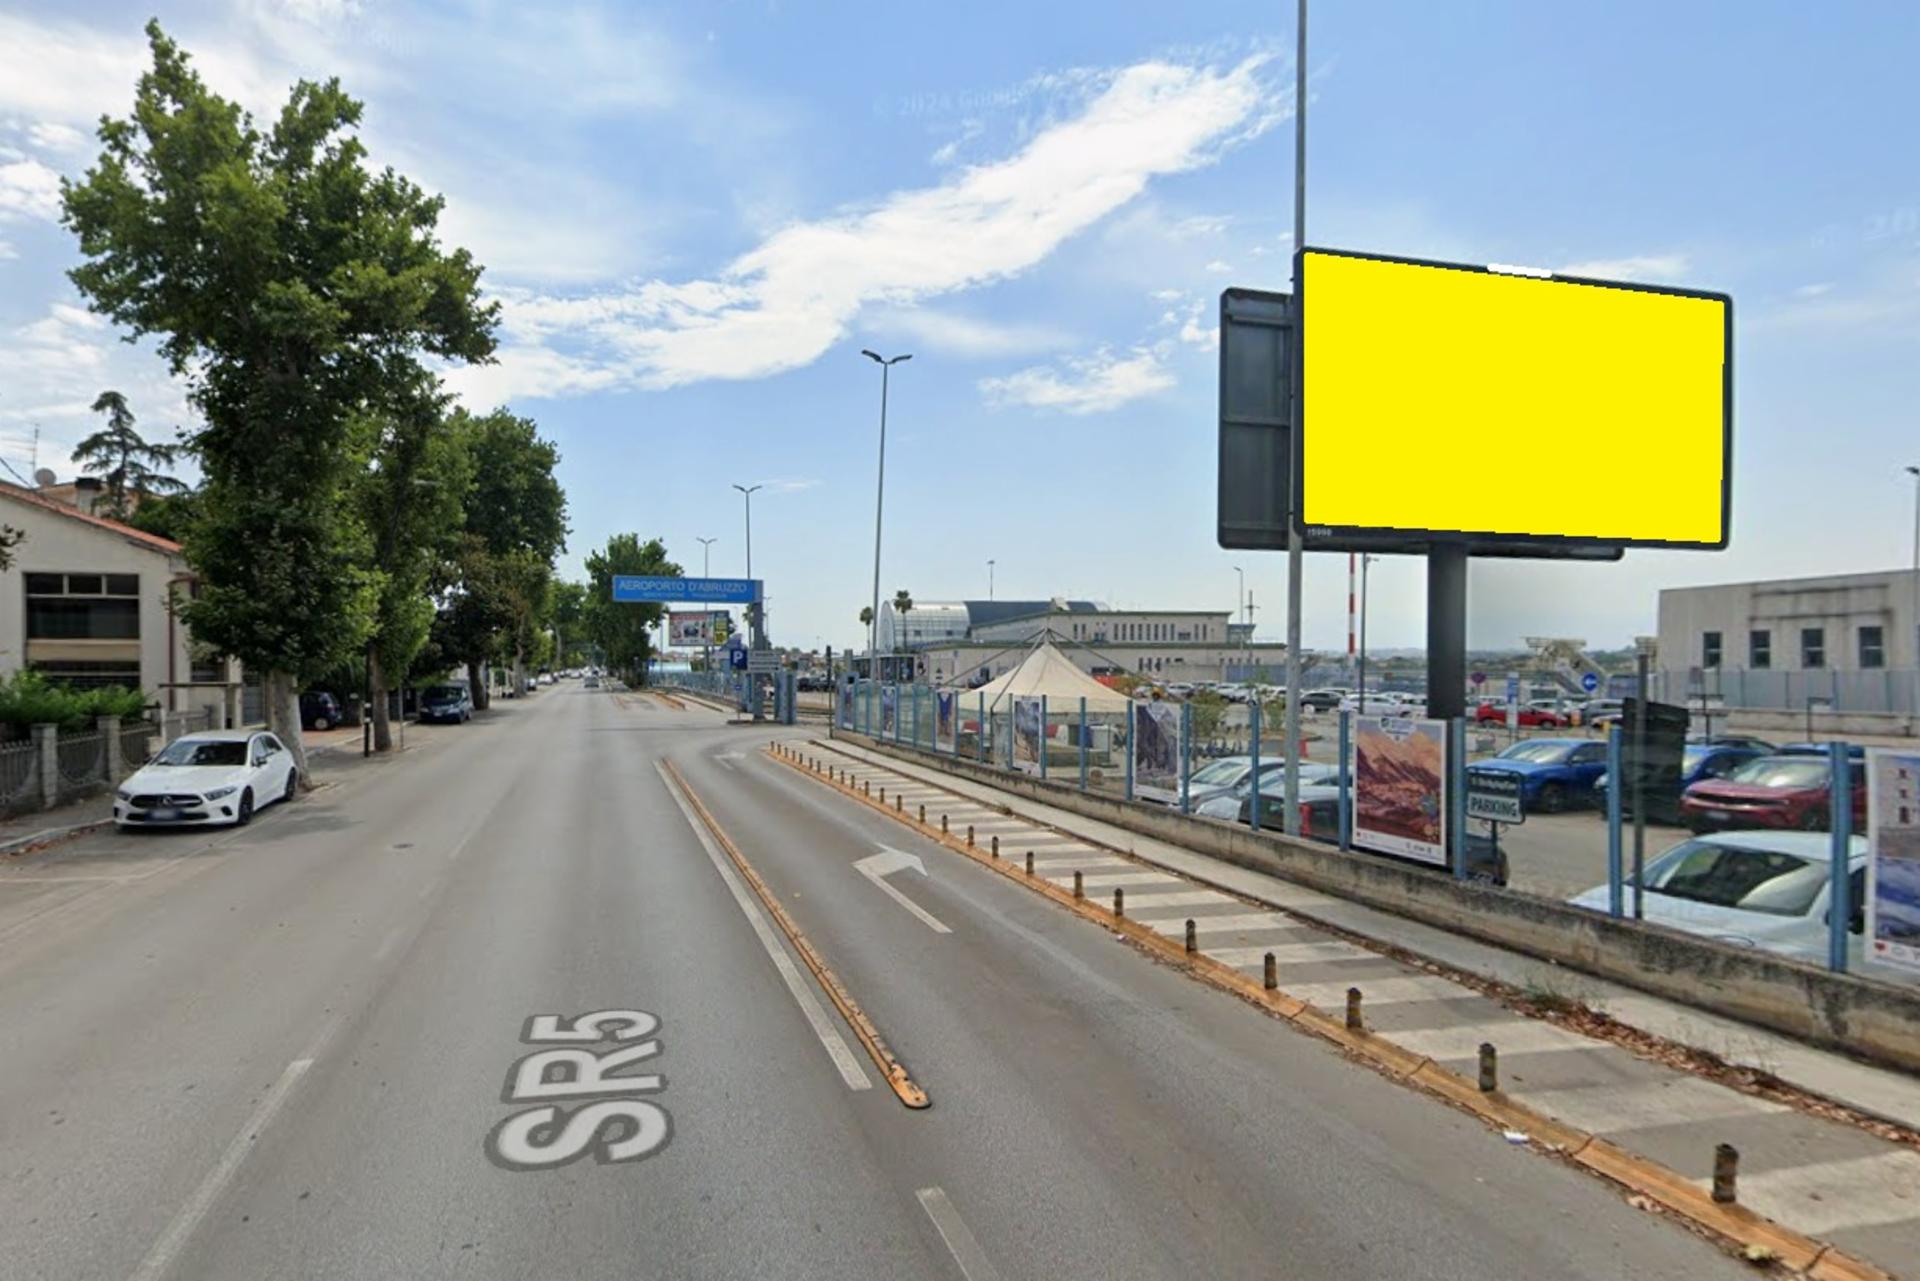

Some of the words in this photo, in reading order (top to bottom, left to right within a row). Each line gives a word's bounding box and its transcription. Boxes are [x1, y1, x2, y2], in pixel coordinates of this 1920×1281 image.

[618, 579, 686, 592] AEROPORTO
[733, 651, 744, 663] P
[1470, 796, 1518, 817] PARKING
